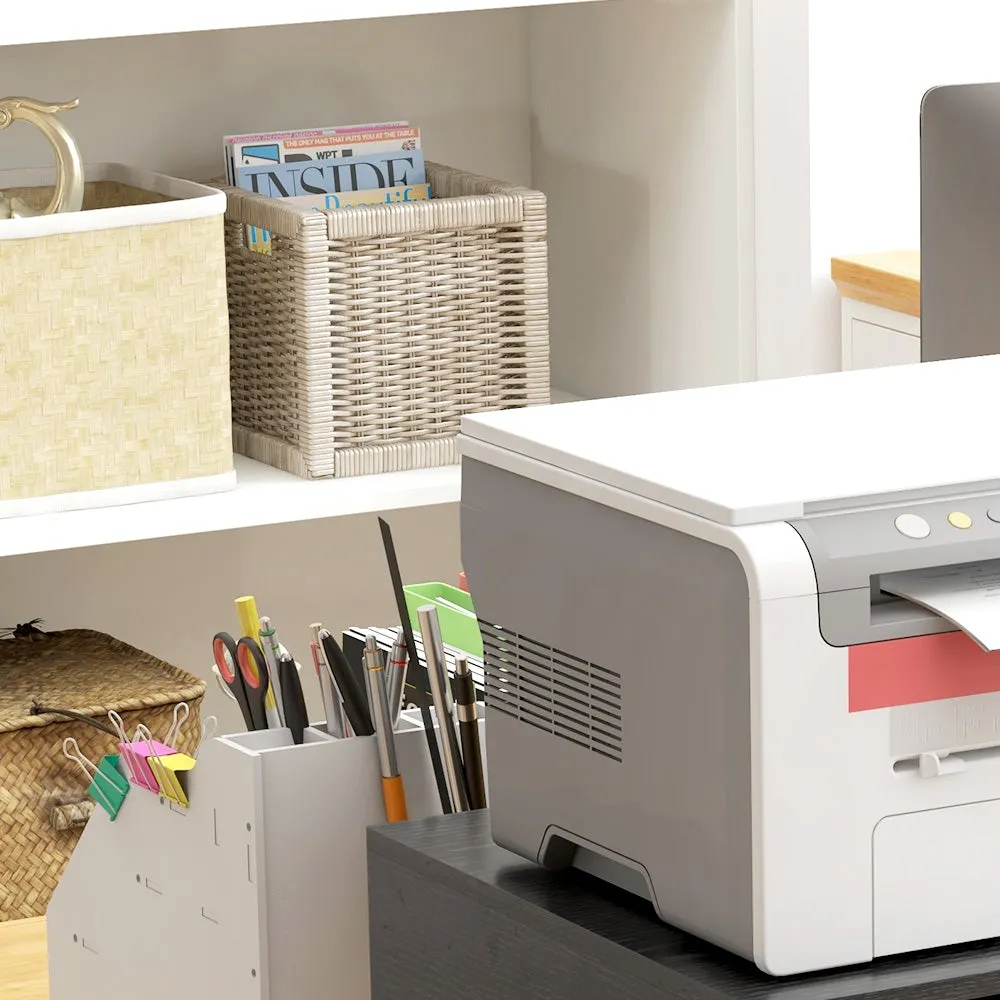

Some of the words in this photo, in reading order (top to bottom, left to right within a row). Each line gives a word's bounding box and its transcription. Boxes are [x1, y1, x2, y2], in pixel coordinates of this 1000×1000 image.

[285, 139, 298, 147] THE
[298, 138, 314, 146] ONLY
[328, 136, 345, 144] THAT
[345, 134, 361, 142] PUTS
[397, 129, 415, 137] TABLE
[316, 150, 338, 160] WPT
[245, 157, 414, 198] INSIDE
